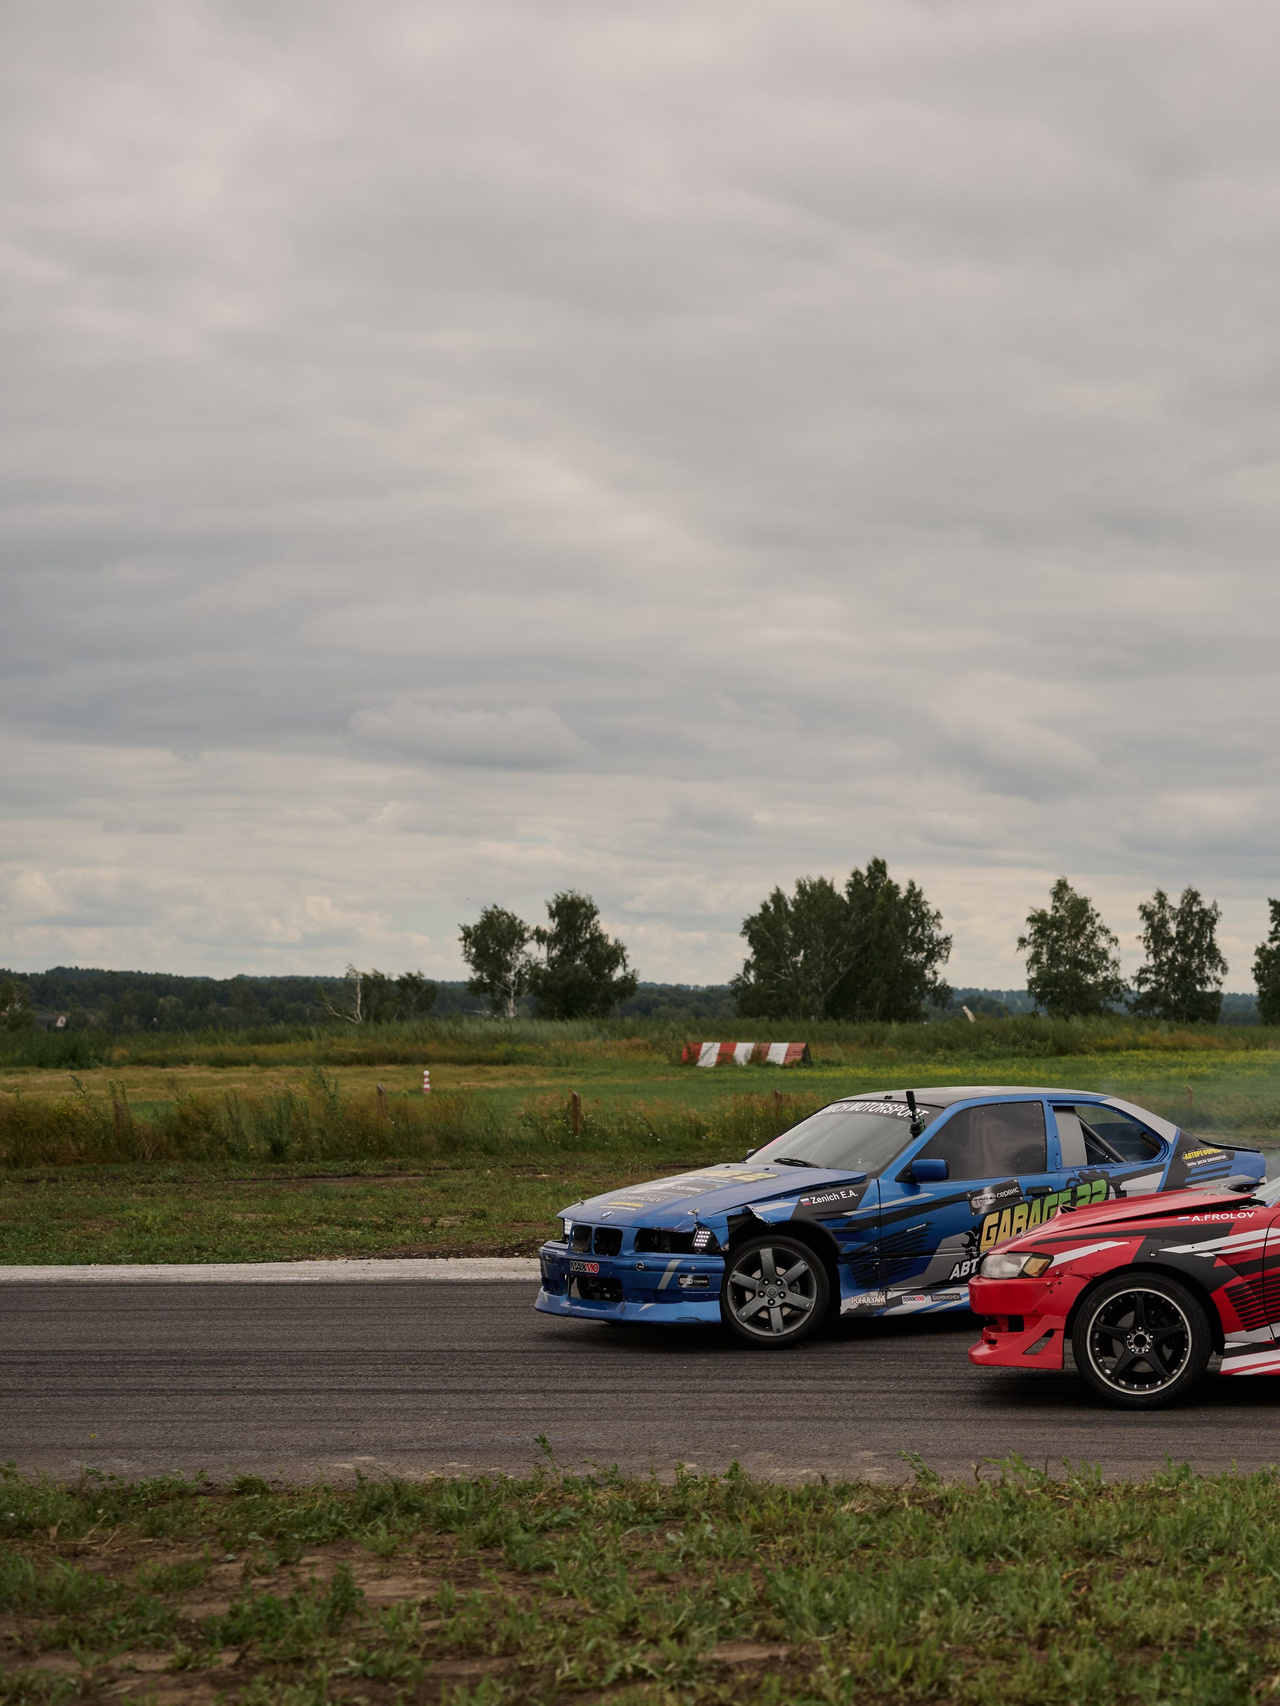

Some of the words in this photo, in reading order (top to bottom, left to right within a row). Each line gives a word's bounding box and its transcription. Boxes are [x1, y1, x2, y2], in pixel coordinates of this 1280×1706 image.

[810, 1192, 840, 1204] Zenich
[840, 1189, 859, 1199] E.A.
[1192, 1211, 1255, 1222] A.FROLOV
[949, 1257, 981, 1280] АВТ
